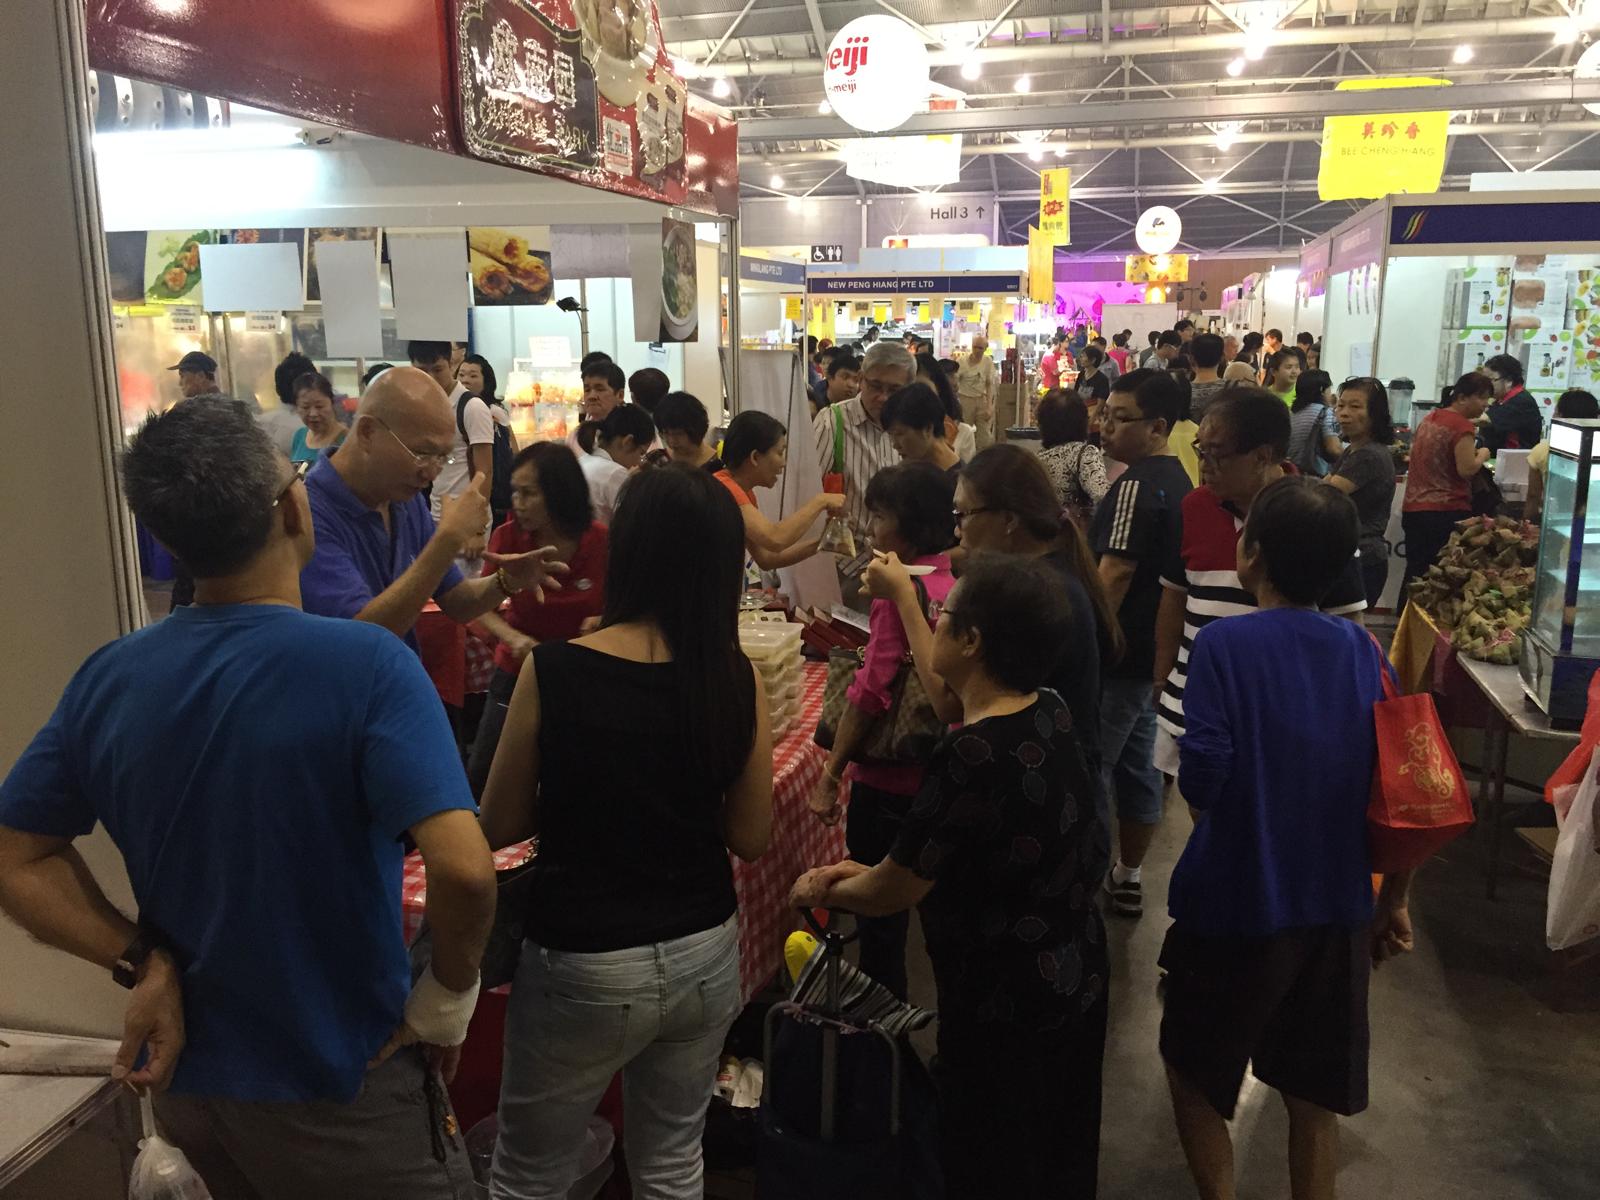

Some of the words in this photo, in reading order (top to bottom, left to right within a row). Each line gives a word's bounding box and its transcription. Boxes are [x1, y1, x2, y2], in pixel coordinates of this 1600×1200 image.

[930, 206, 957, 219] Hall
[960, 207, 968, 218] 3
[827, 281, 846, 289] NEW
[848, 281, 870, 289] PENG
[872, 280, 898, 288] HIANG
[901, 280, 917, 288] PTE
[919, 280, 934, 288] LTD
